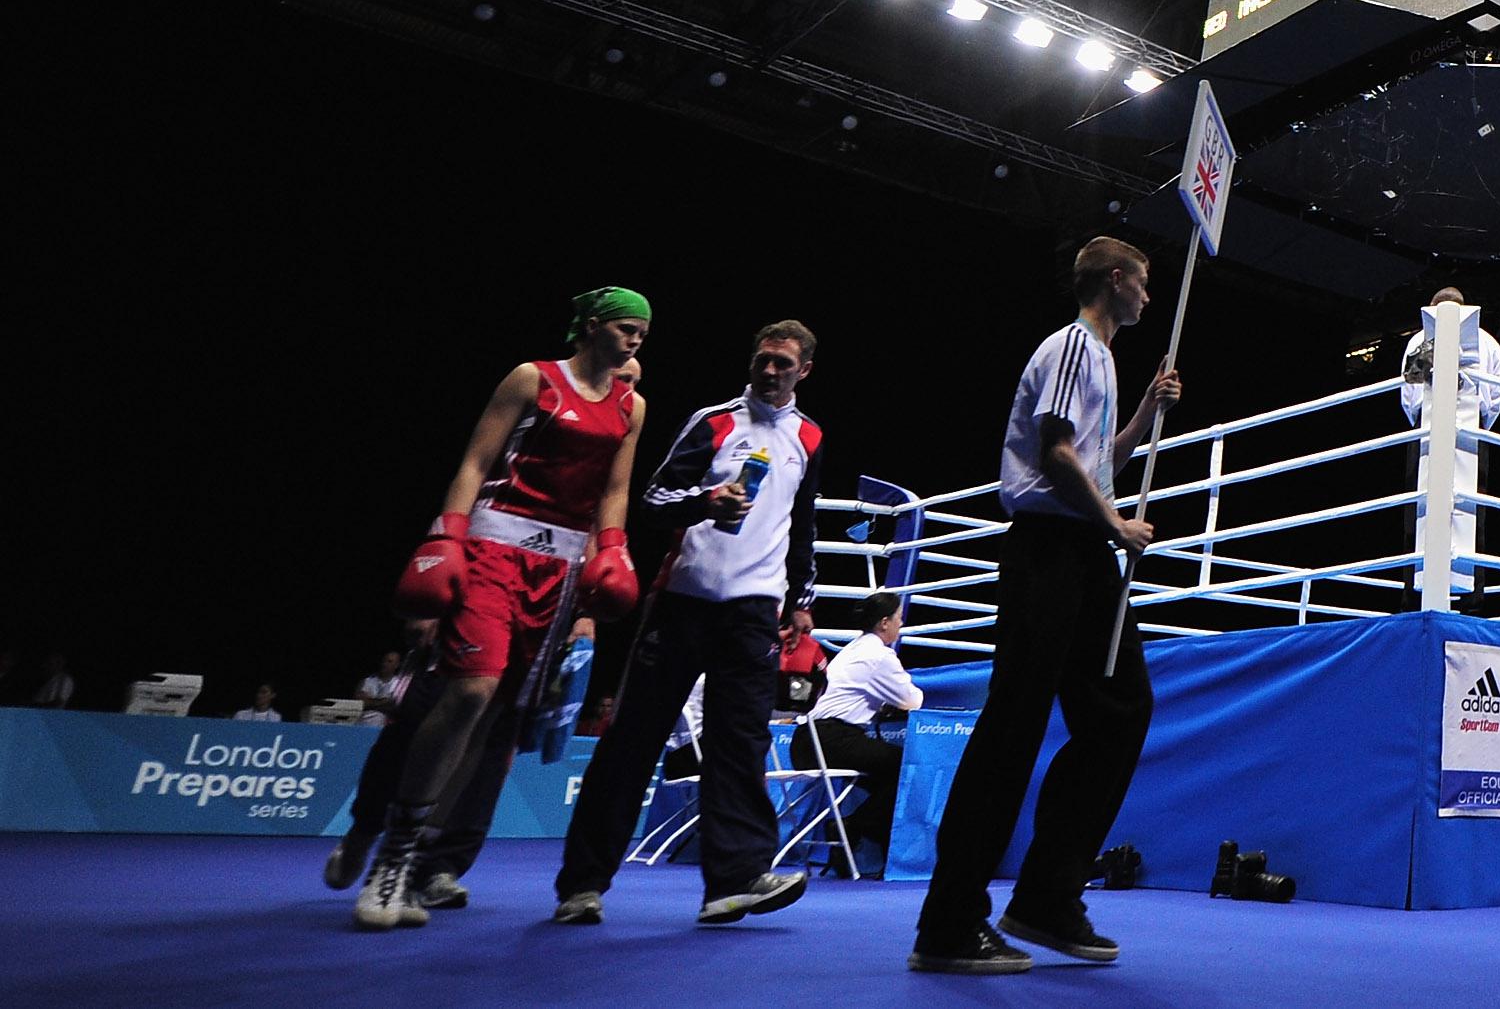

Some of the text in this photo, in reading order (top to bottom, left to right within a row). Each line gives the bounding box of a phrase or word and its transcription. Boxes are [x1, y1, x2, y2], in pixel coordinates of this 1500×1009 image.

[1205, 115, 1225, 166] GBR
[916, 721, 951, 734] London
[185, 734, 324, 770] London
[131, 761, 316, 807] Prepares
[248, 801, 308, 819] series
